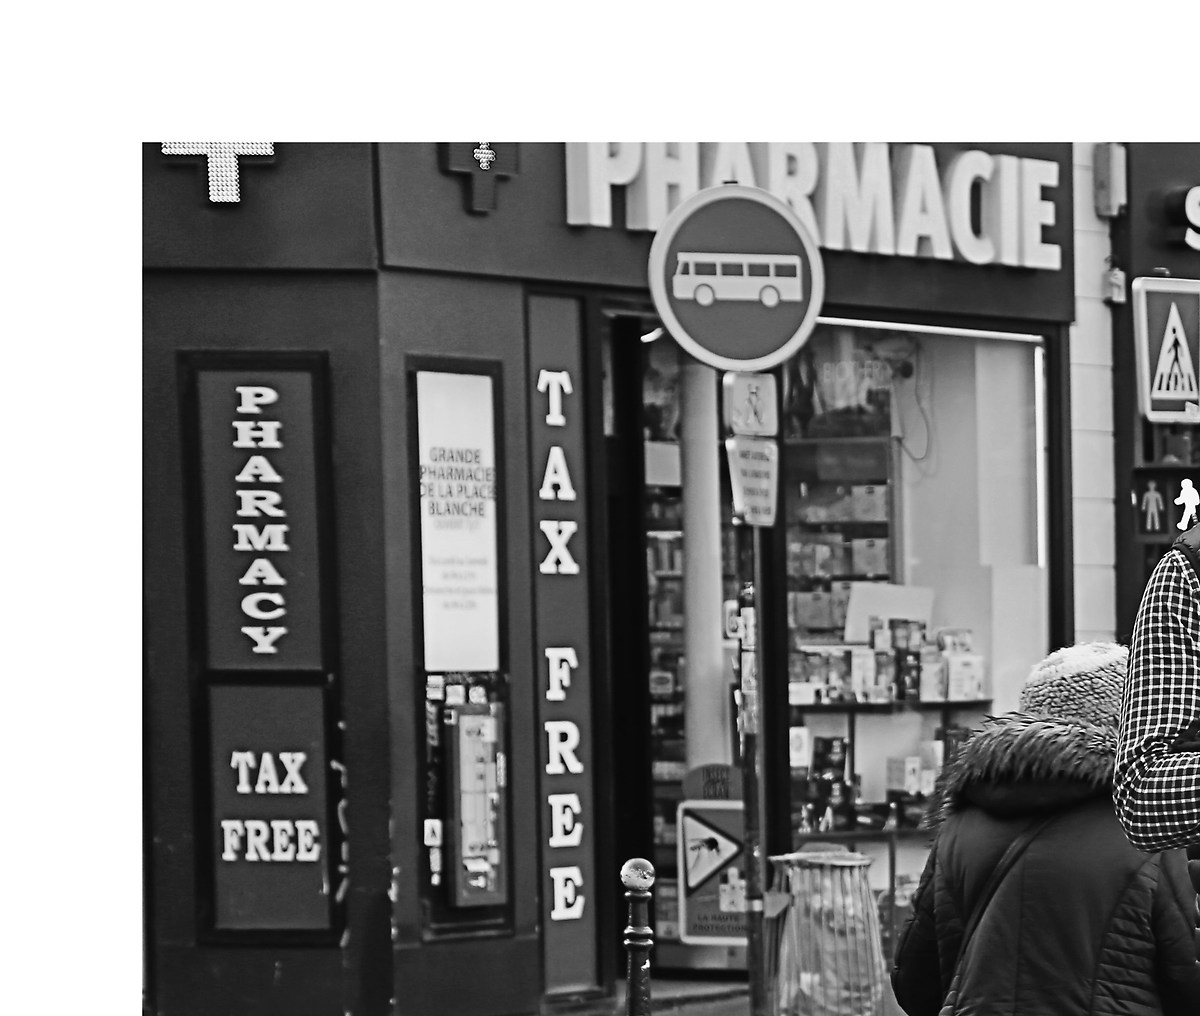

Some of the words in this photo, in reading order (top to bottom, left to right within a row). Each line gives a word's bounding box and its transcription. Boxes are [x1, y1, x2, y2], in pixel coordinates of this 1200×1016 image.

[419, 465, 494, 481] PHARMACIE
[429, 447, 481, 463] GRANDE
[537, 370, 580, 575] TAX
[420, 482, 434, 497] DE
[438, 483, 453, 498] LA
[456, 484, 496, 499] PLACE
[428, 501, 485, 516] BLANCHE
[232, 386, 290, 654] PHARMACY
[230, 751, 308, 794] TAX
[544, 647, 586, 920] FREE
[221, 819, 321, 862] FREE
